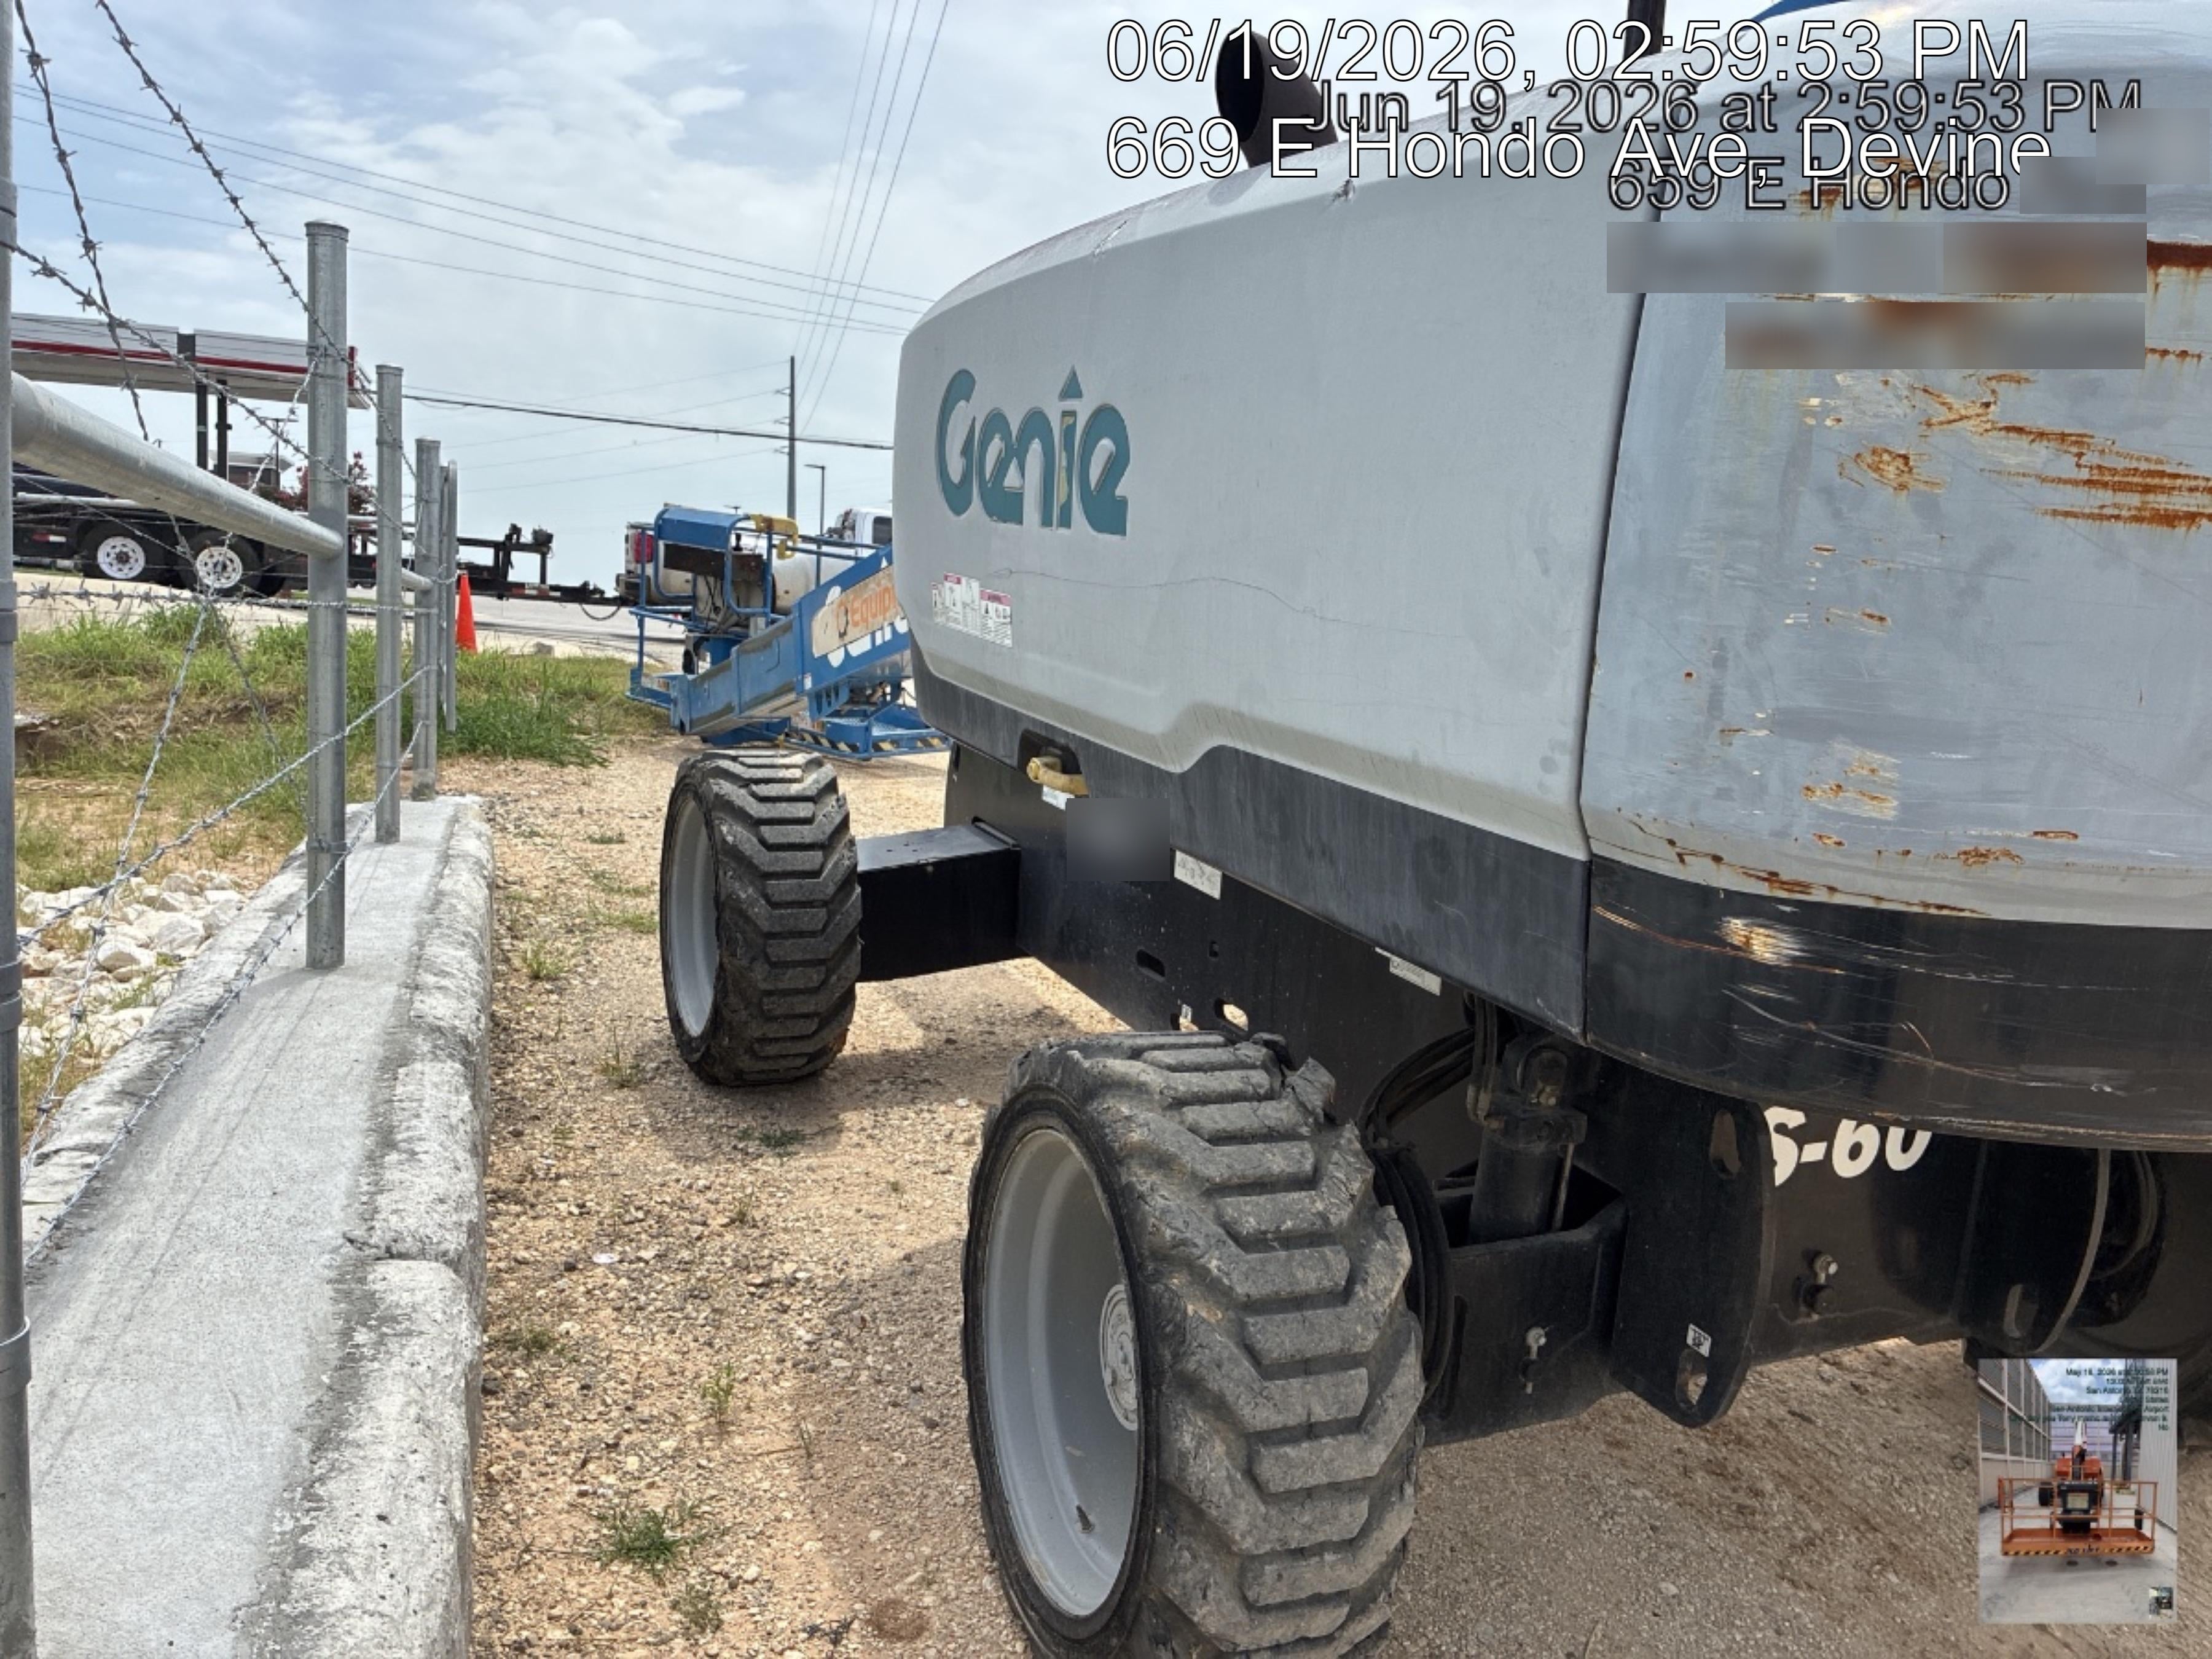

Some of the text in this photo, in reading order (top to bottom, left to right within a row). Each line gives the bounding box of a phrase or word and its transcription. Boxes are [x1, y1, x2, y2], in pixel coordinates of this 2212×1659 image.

[936, 364, 1131, 537] Genie
[850, 585, 896, 629] Equip
[1763, 1106, 1933, 1188] S-60
